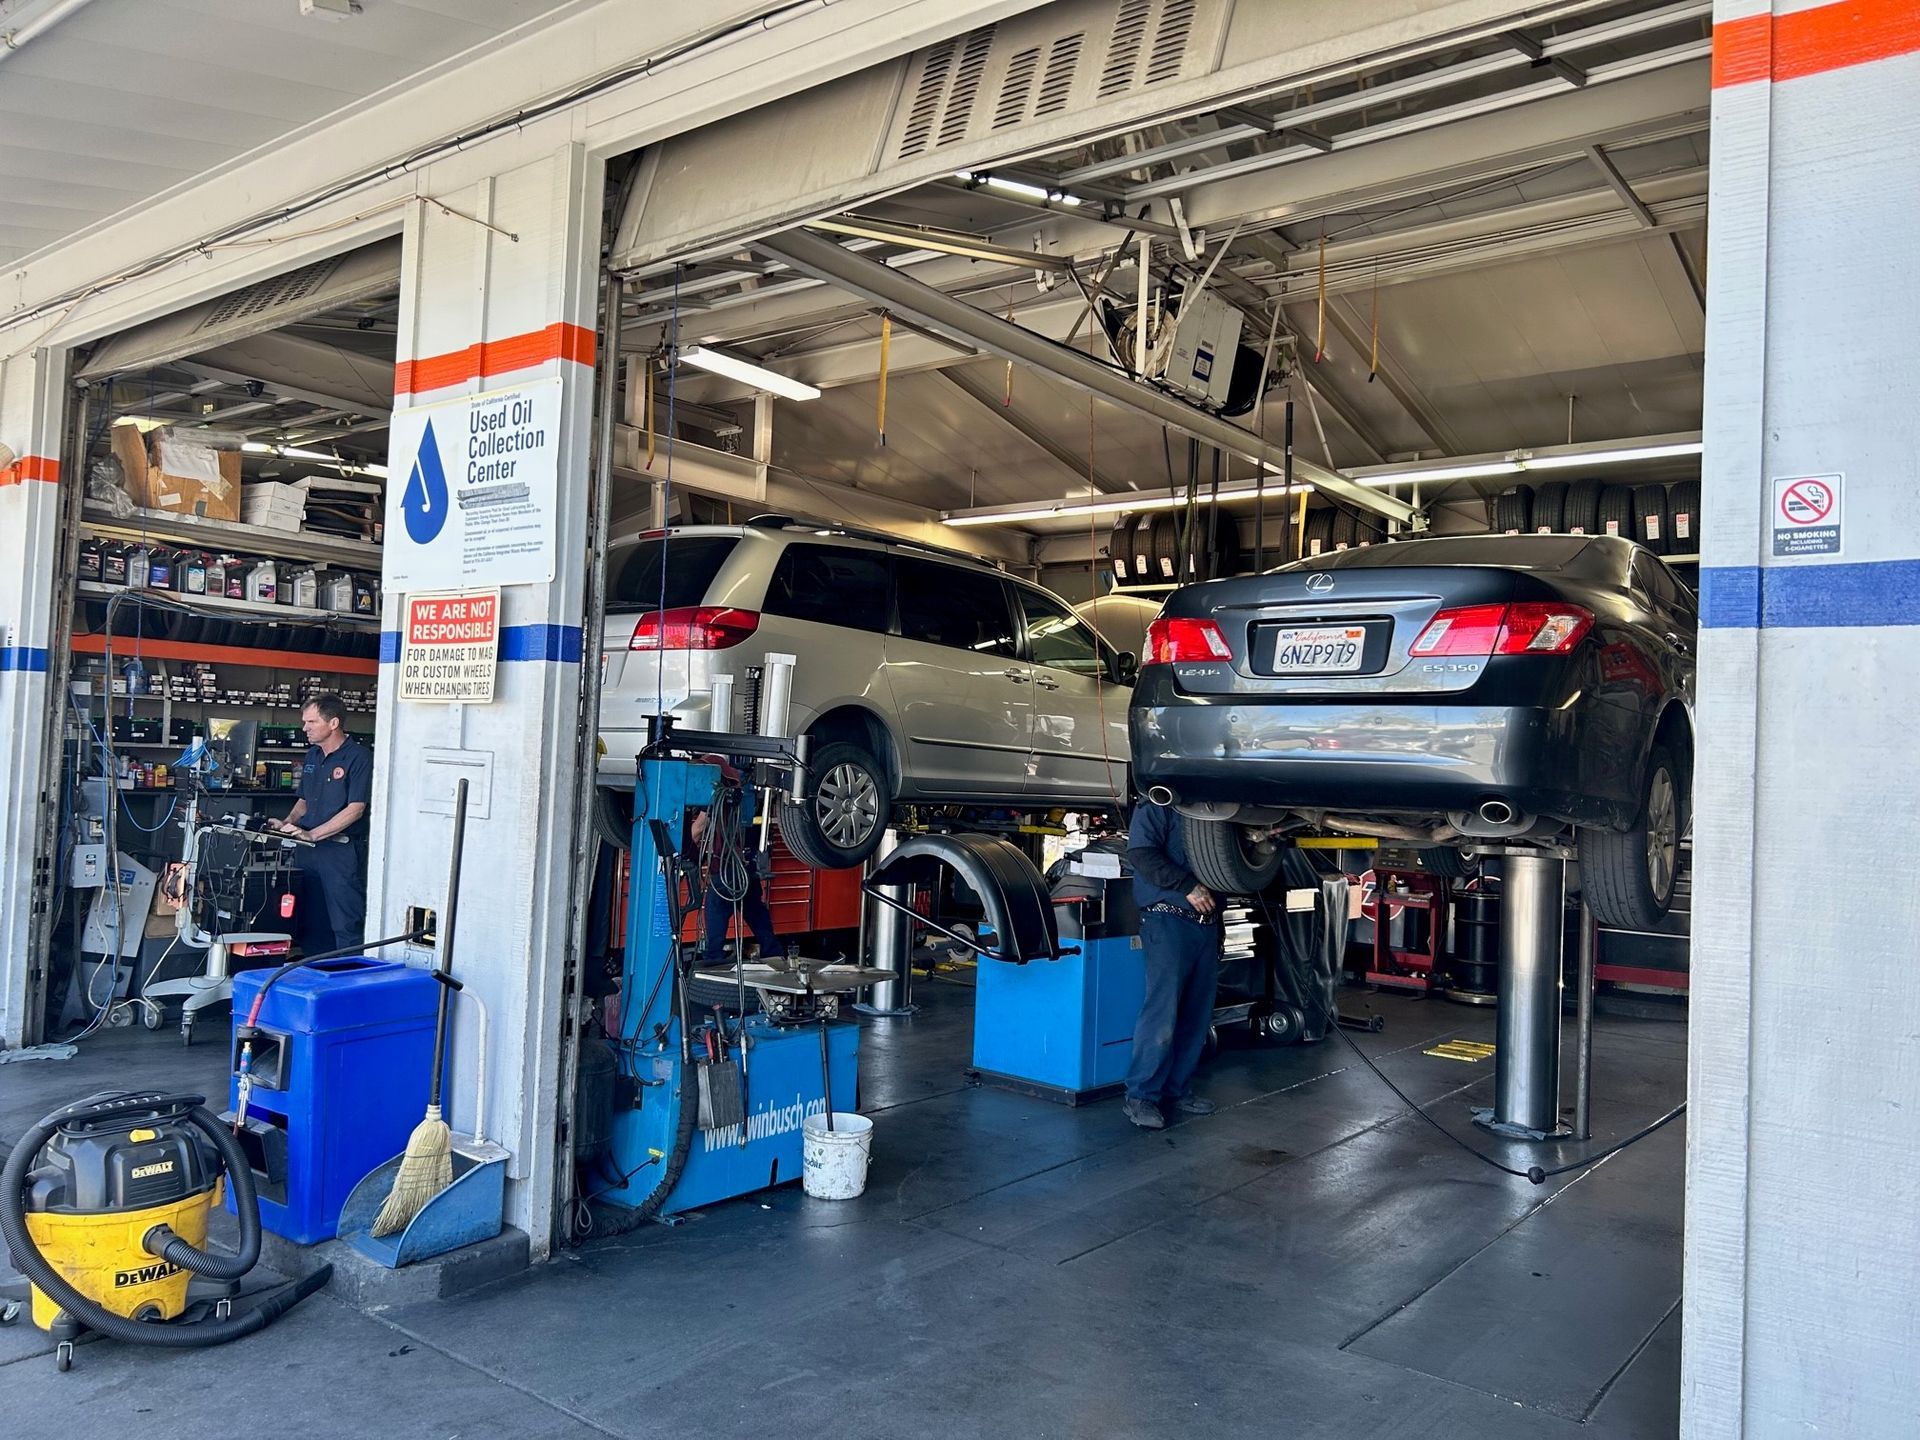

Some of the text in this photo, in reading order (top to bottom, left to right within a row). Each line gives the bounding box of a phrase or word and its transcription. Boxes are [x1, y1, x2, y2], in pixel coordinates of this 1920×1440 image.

[470, 399, 532, 434] Used Oil
[469, 426, 545, 459] Collection
[467, 459, 517, 484] Center
[1793, 530, 1836, 539] SMOKING
[416, 601, 493, 620] WE ARE NOT
[413, 621, 493, 640] RESPONSIBLE
[1282, 632, 1294, 640] NOV
[1295, 630, 1345, 645] California
[407, 646, 494, 661] FOR DAMAGE TO MAG
[1280, 643, 1357, 665] 6NZP979
[406, 664, 492, 678] OR CUSTOM WHEELS
[1423, 663, 1479, 673] ES 350
[405, 681, 490, 695] WHEN CHANGING TIRES
[115, 1262, 183, 1285] DEWAL
